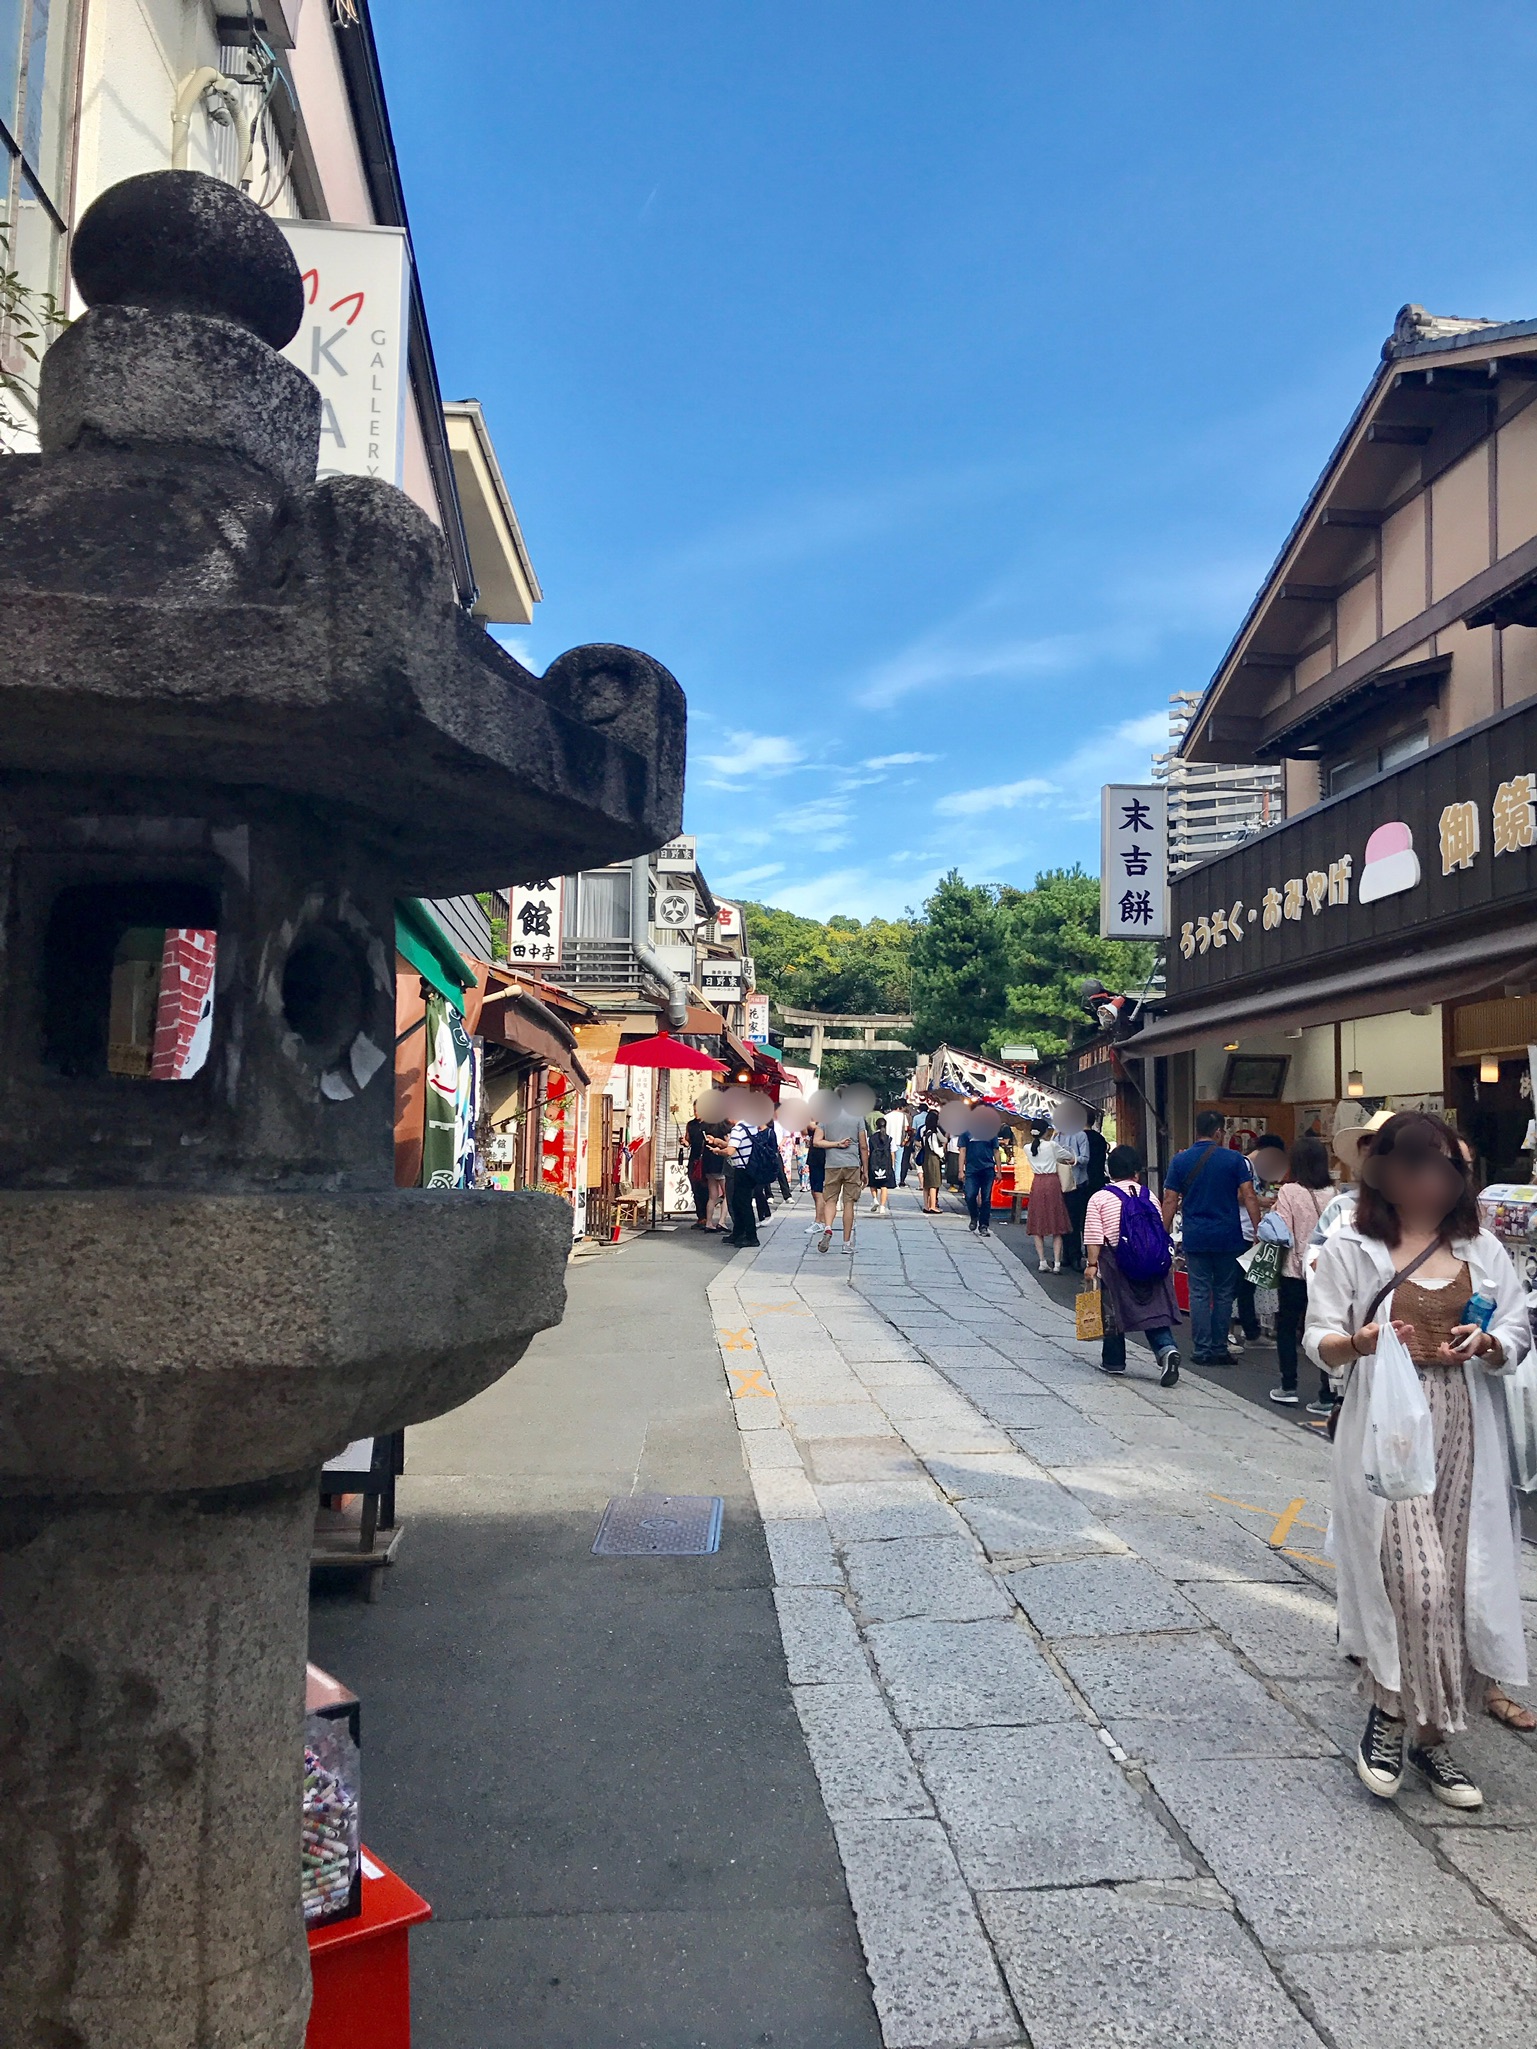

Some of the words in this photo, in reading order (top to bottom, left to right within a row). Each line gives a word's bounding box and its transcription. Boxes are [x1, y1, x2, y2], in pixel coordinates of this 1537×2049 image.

[311, 326, 348, 479] KA
[367, 330, 386, 476] GALLERY
[660, 849, 692, 859] 日野家
[1118, 797, 1155, 927] 末吉餅
[1179, 854, 1353, 960] ろうそく・おみやげ
[513, 943, 556, 961] 田中亭
[705, 976, 738, 987] 日野家
